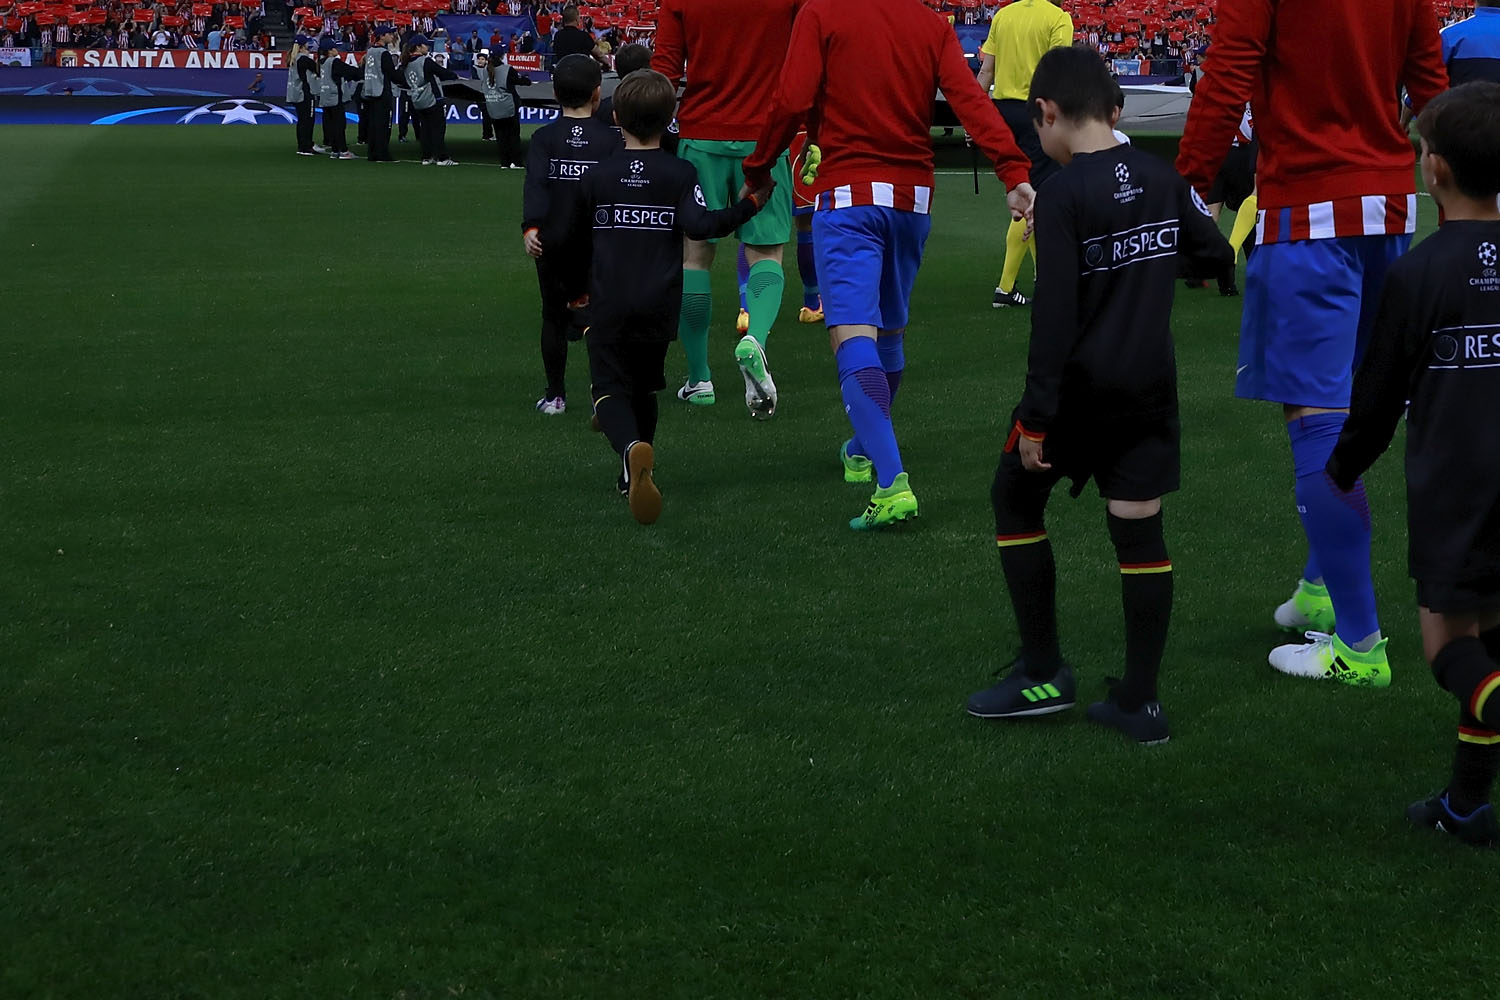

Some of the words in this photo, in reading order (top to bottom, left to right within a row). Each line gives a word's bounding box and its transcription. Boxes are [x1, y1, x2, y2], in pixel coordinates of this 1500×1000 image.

[83, 50, 176, 69] SANTA
[184, 51, 240, 69] ANA
[250, 52, 283, 70] DE
[614, 209, 675, 225] RESPECT
[1113, 227, 1180, 261] RESPECT
